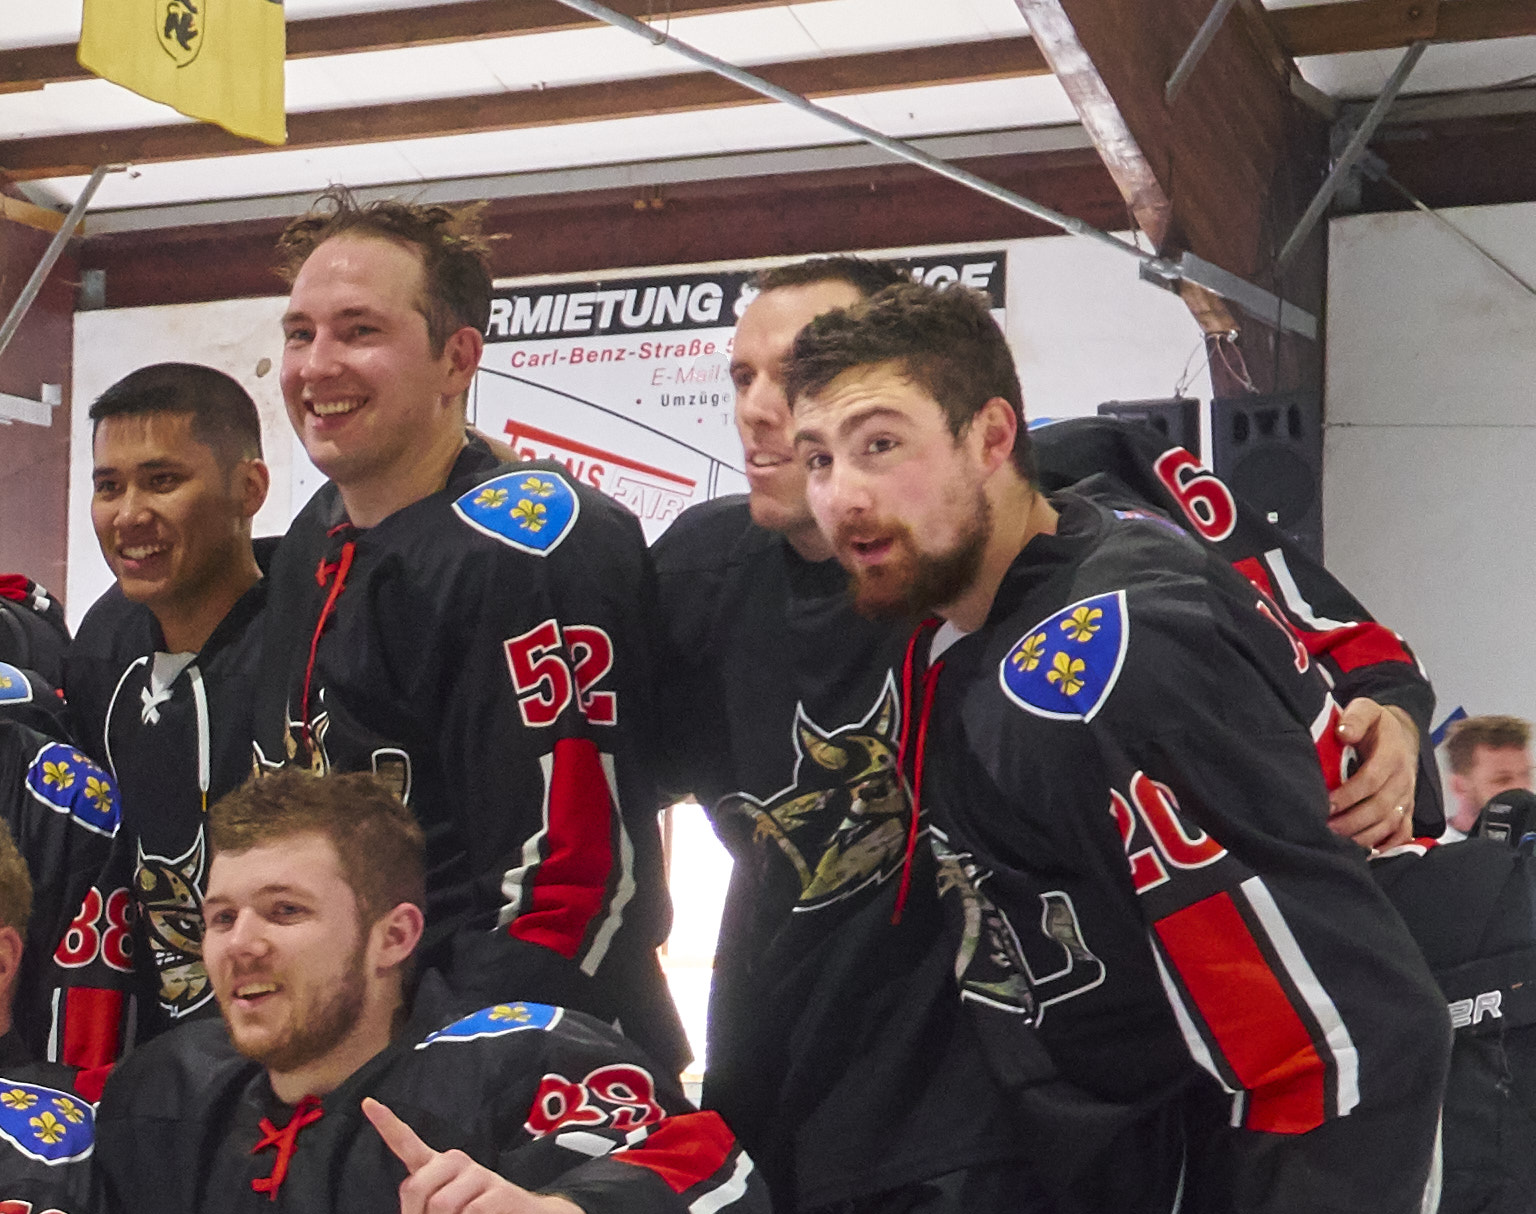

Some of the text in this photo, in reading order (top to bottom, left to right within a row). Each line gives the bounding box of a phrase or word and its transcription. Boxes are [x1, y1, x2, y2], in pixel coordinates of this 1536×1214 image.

[511, 339, 716, 369] Carl-Benz-Straße
[503, 618, 618, 727] 52
[53, 886, 135, 972] 88
